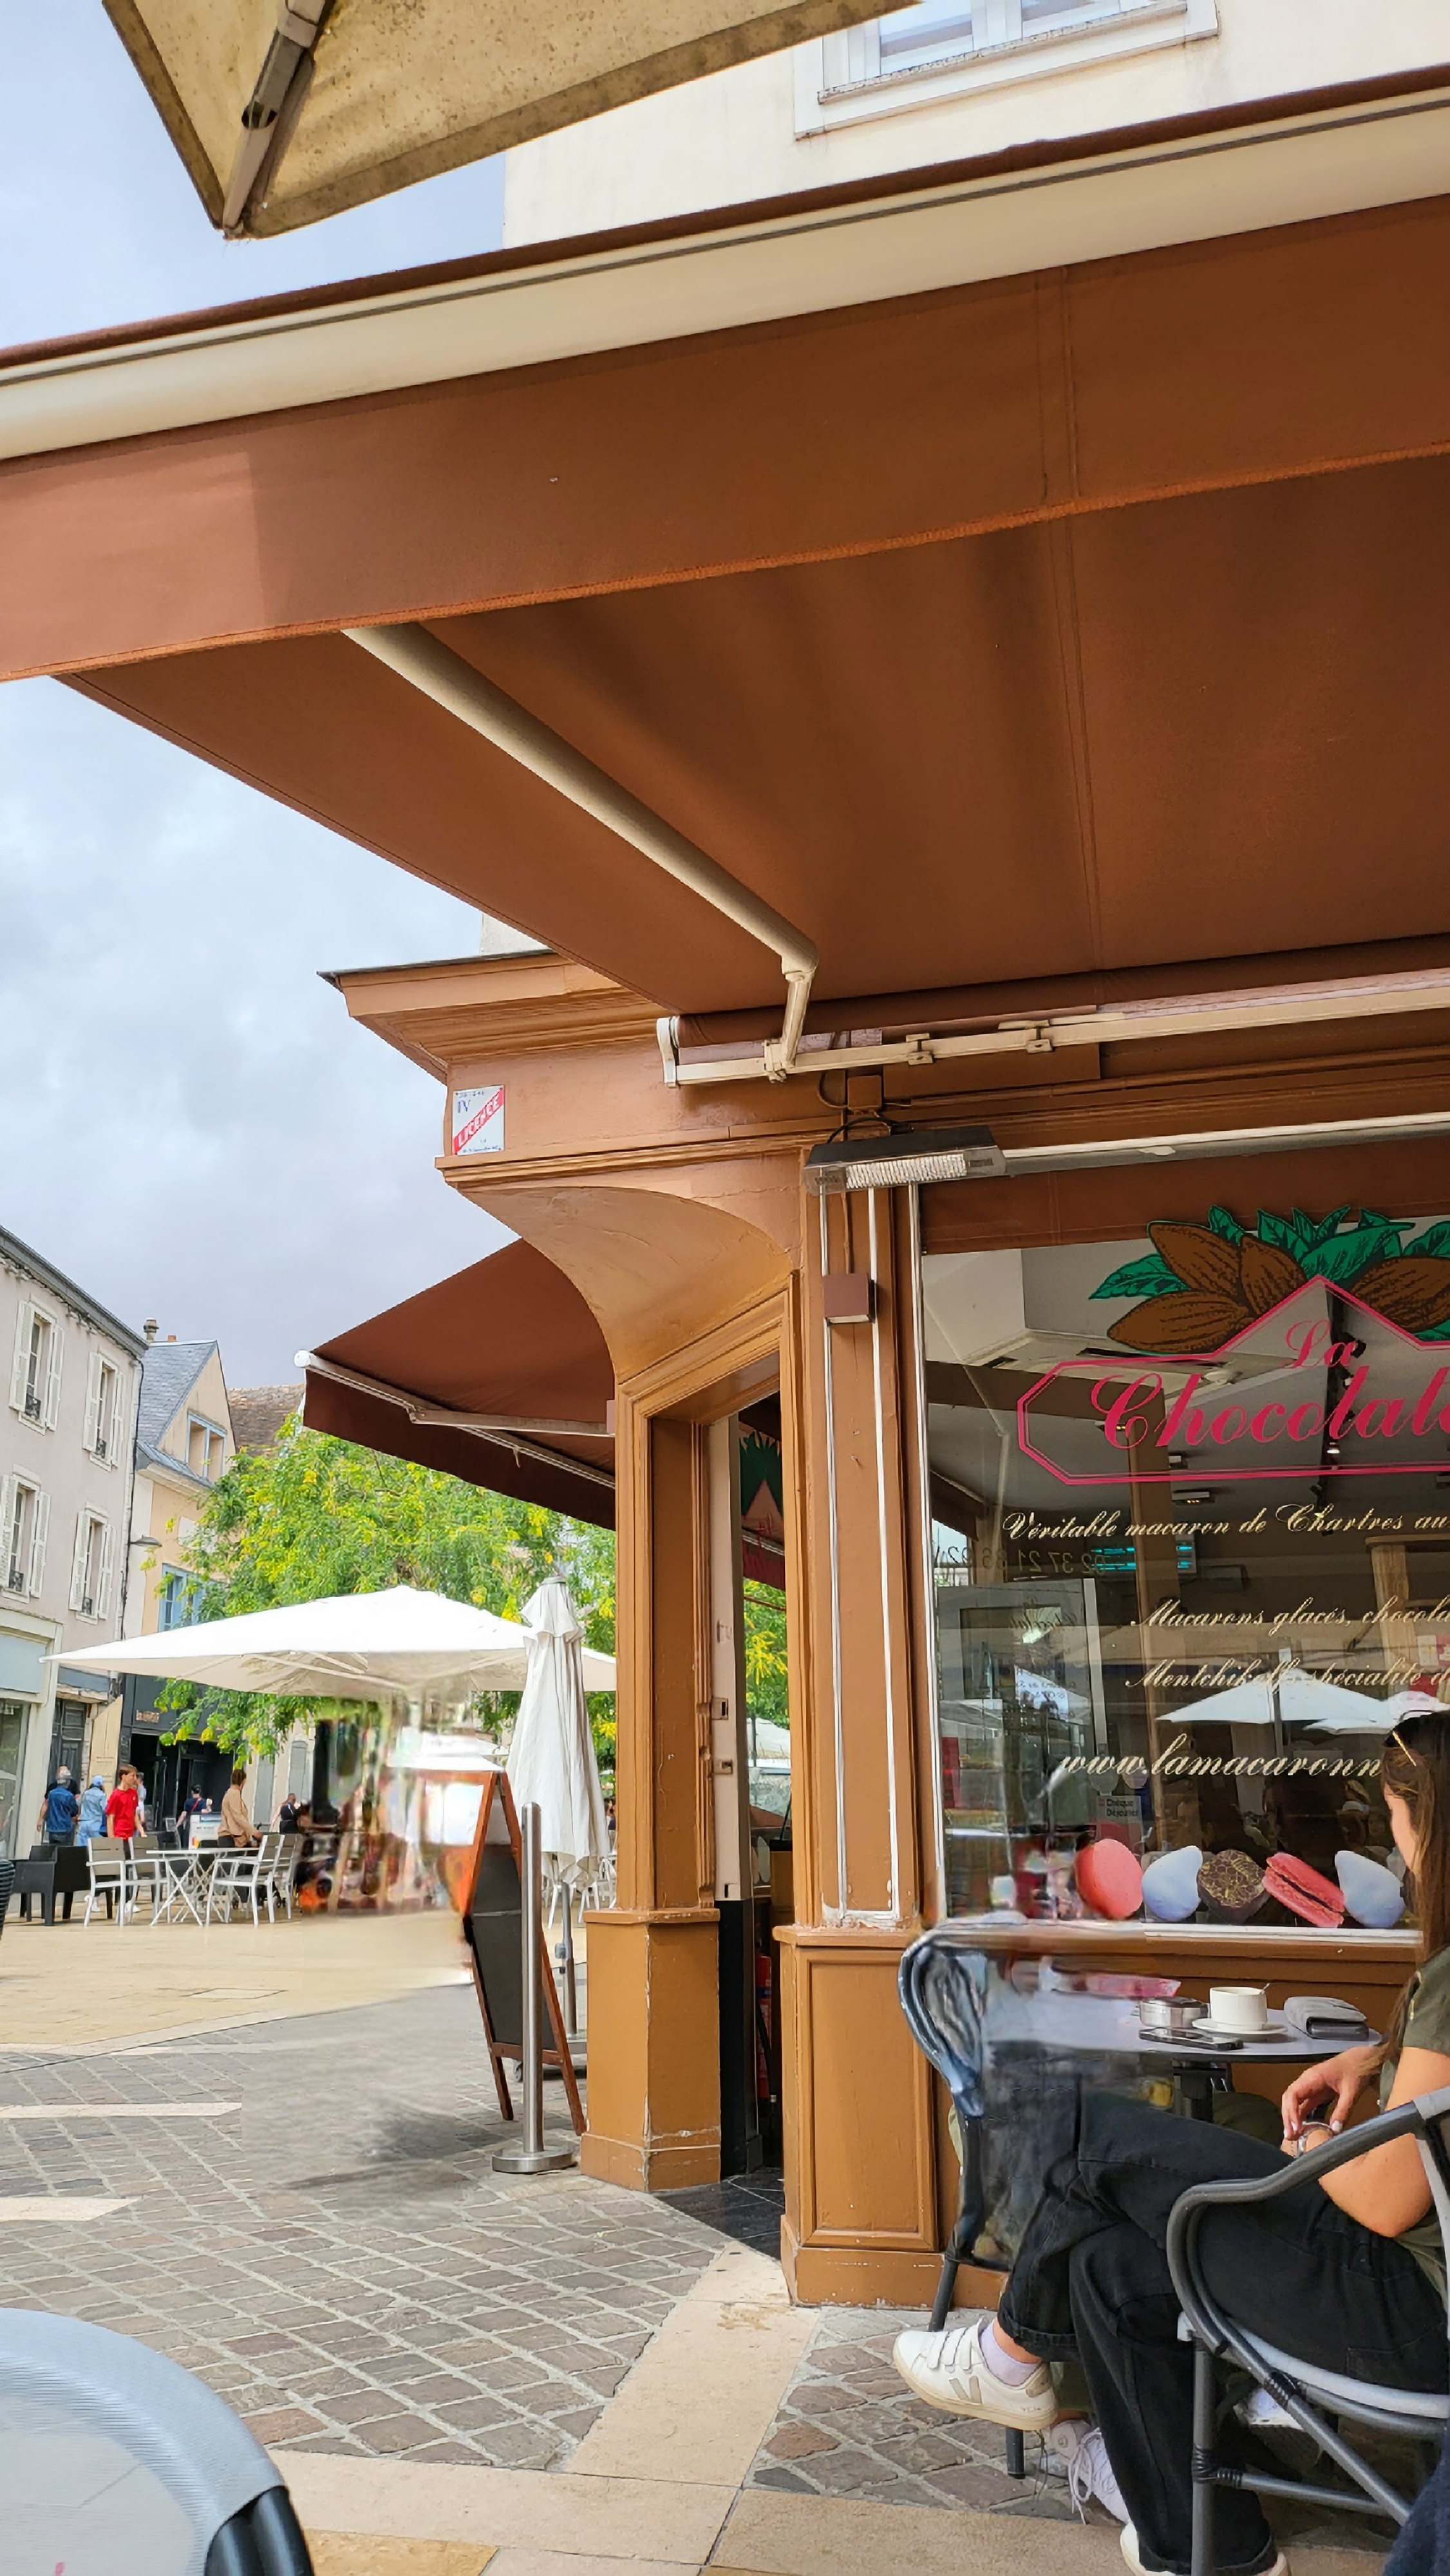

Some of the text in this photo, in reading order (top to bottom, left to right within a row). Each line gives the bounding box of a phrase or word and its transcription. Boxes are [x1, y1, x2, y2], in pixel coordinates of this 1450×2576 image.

[1285, 1319, 1357, 1368] La
[1002, 1502, 1450, 1540] Véritable macaron de Chartres au
[1130, 1598, 1265, 1627] Macarons
[1267, 1596, 1351, 1637] glacés,
